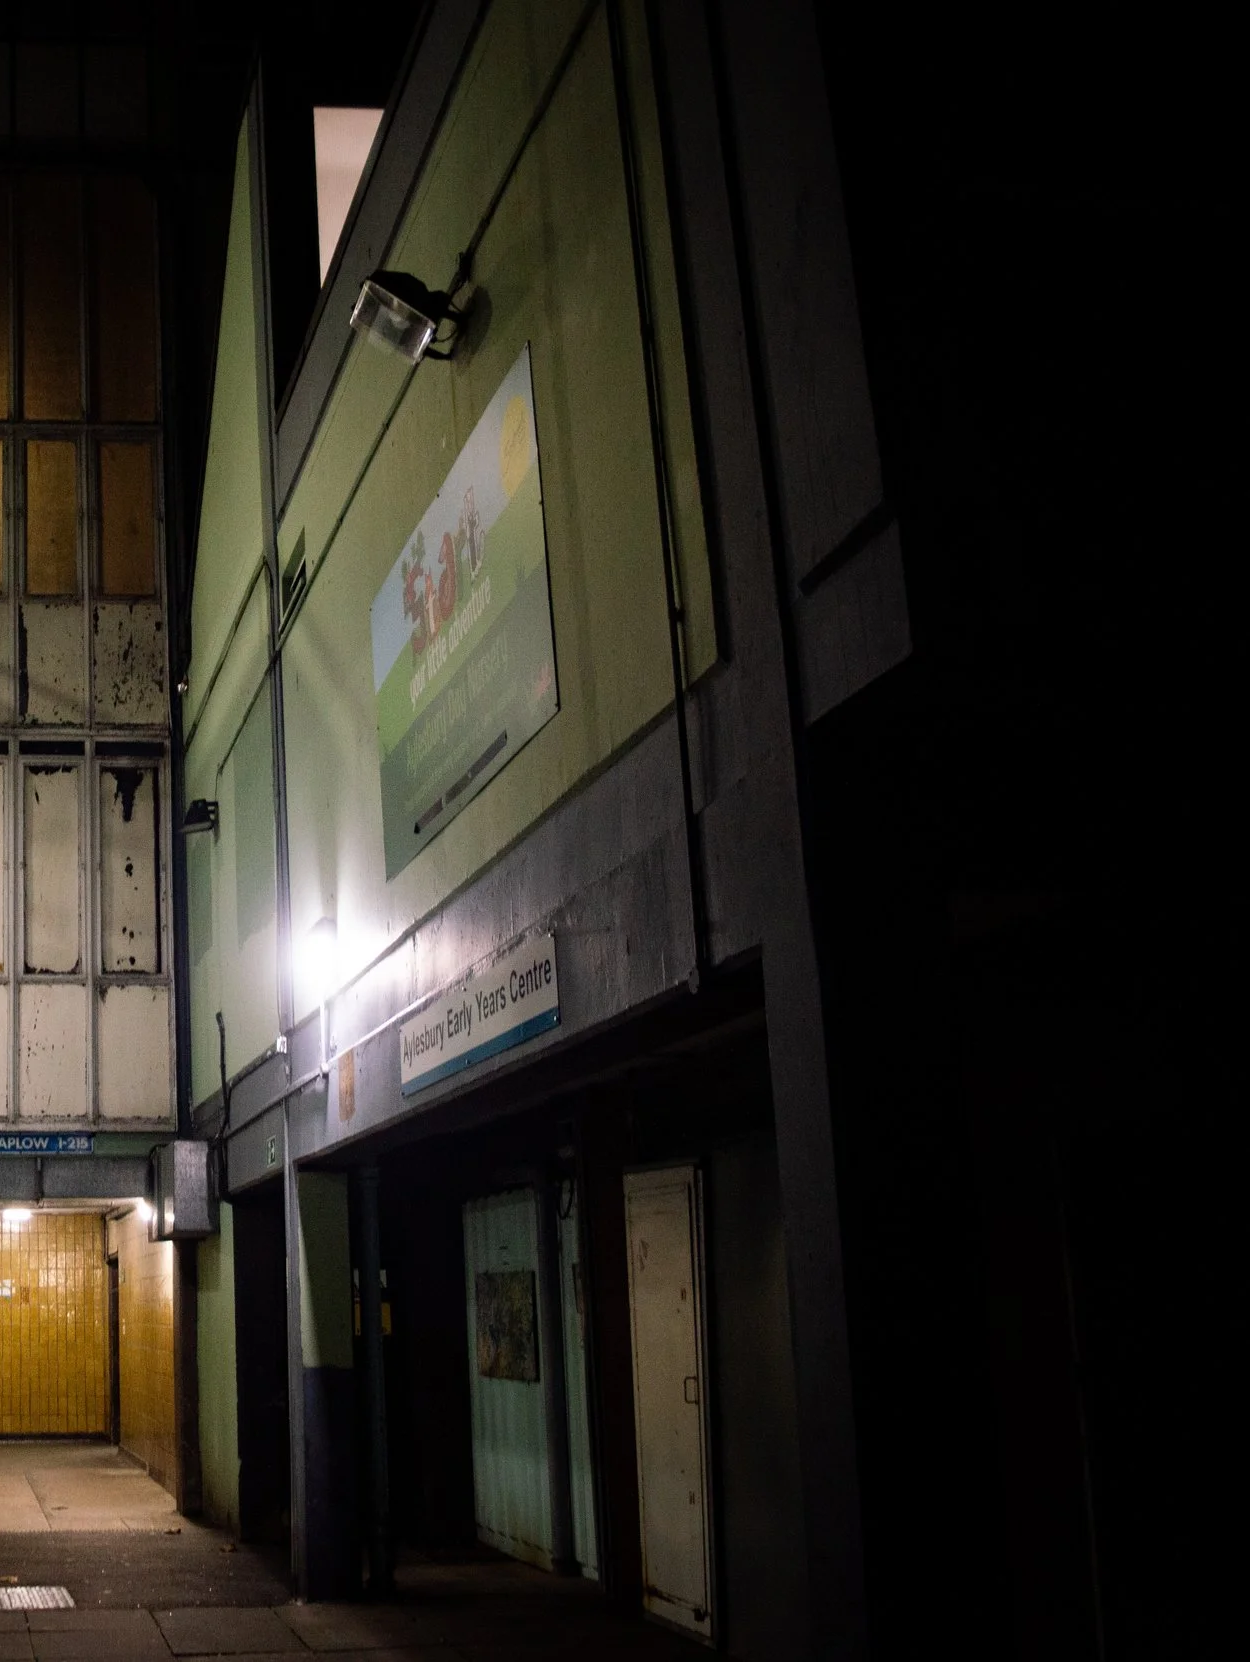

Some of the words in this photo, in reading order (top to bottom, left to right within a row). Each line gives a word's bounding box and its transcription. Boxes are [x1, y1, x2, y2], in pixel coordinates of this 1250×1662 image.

[405, 704, 447, 778] Aylesbury
[448, 681, 467, 728] Day
[467, 633, 509, 703] Nursery
[409, 664, 427, 713] your
[427, 630, 447, 682] little
[448, 575, 491, 655] adventure
[403, 1020, 445, 1067] Aylesbury
[446, 1001, 472, 1038] Early
[475, 985, 507, 1022] Years
[509, 958, 552, 1003] Centre
[58, 1137, 88, 1149] 1-215
